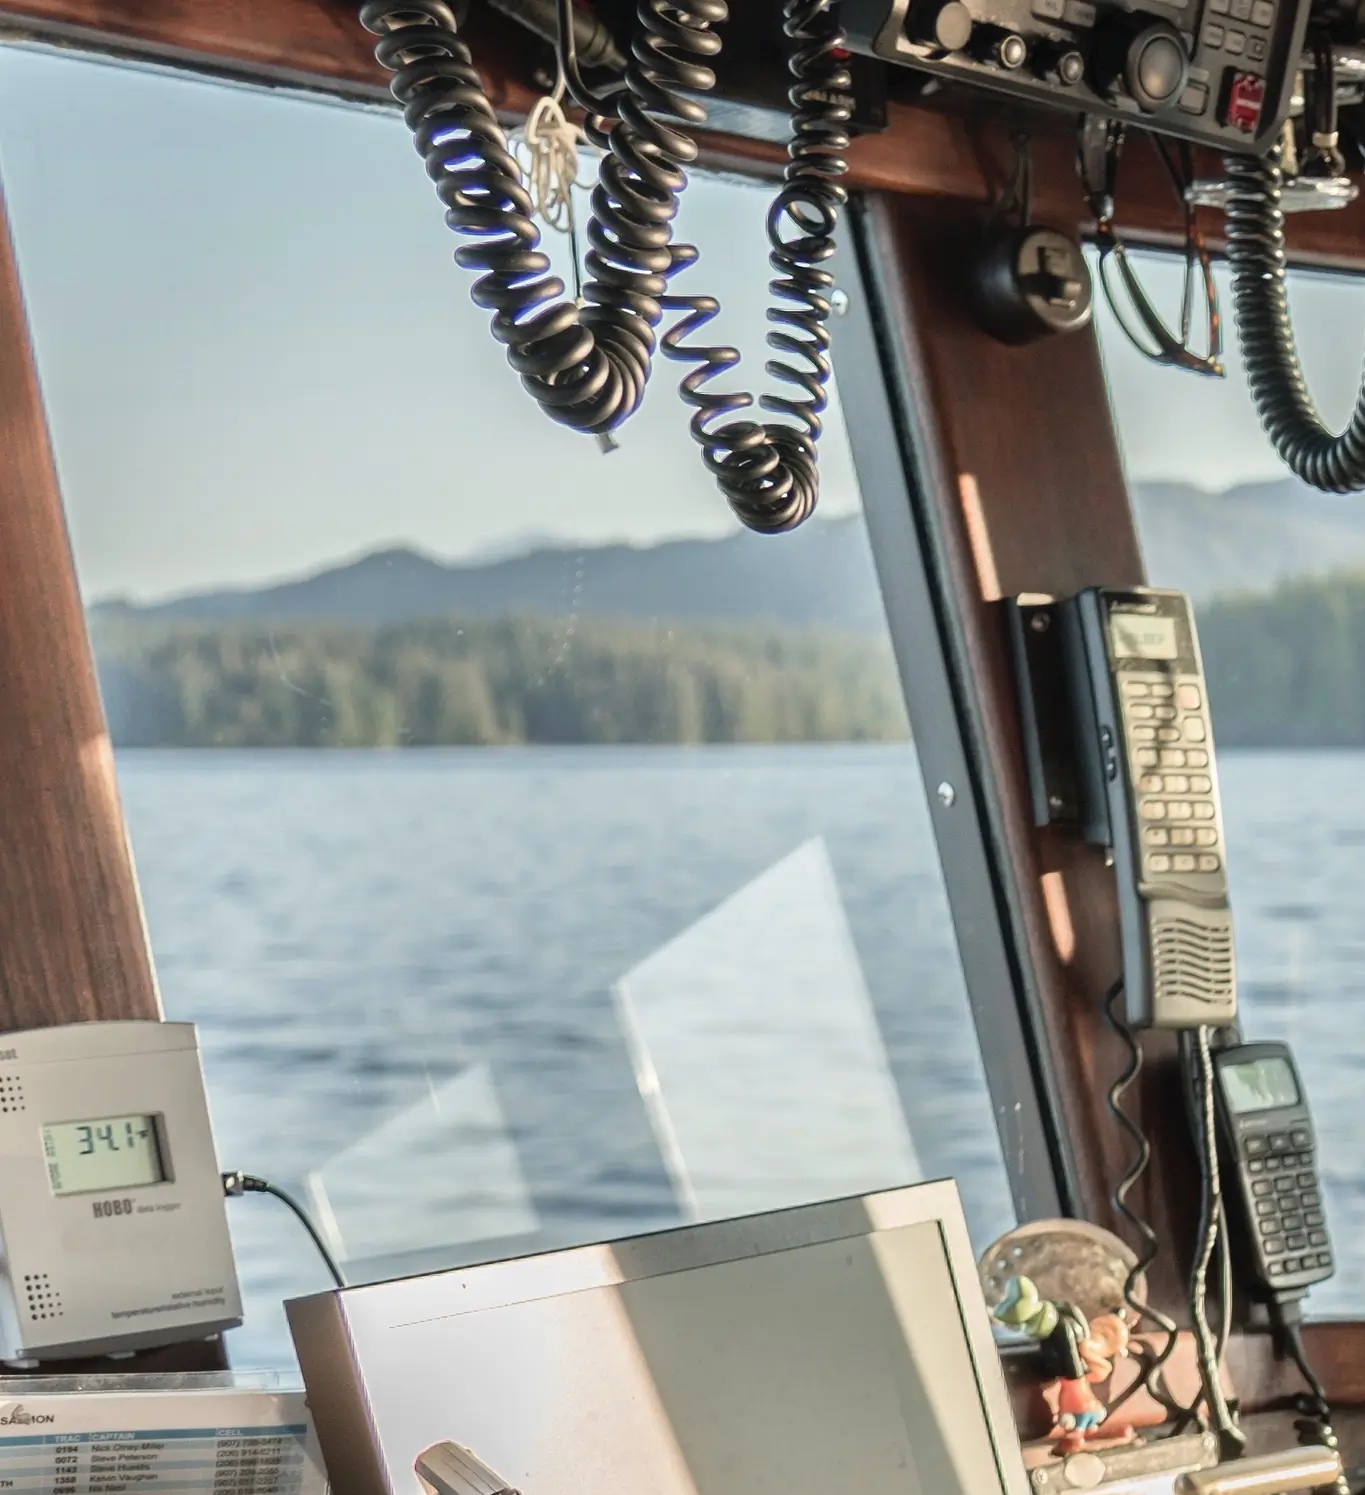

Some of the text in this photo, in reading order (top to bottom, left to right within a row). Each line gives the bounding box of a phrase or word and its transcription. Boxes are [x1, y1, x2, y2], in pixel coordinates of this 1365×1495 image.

[92, 1198, 133, 1219] HOBO
[93, 1432, 136, 1442] CAPTAIN
[218, 1428, 243, 1436] CELL
